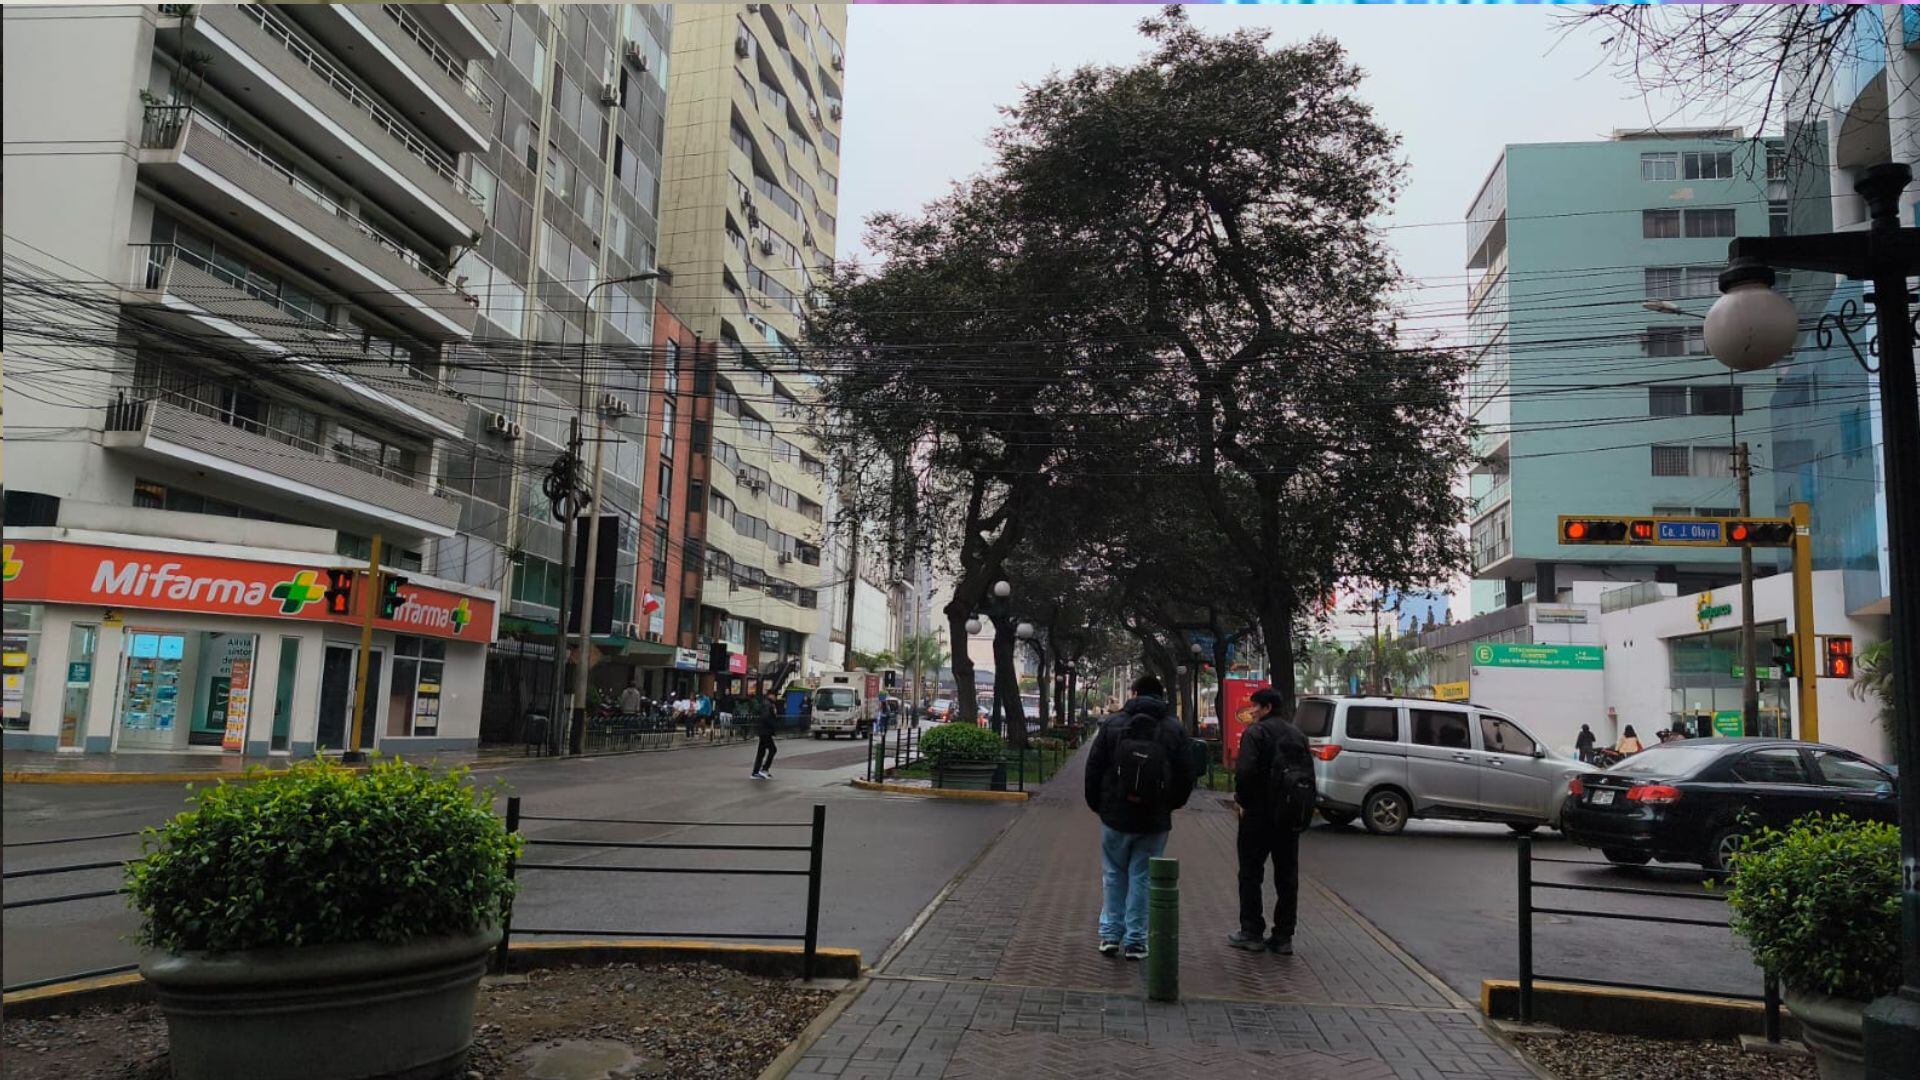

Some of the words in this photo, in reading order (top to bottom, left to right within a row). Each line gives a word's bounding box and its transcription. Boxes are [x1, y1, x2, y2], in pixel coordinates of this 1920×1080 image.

[1635, 524, 1650, 538] 41
[1692, 525, 1716, 540] Olaya
[91, 560, 267, 606] Mifarma
